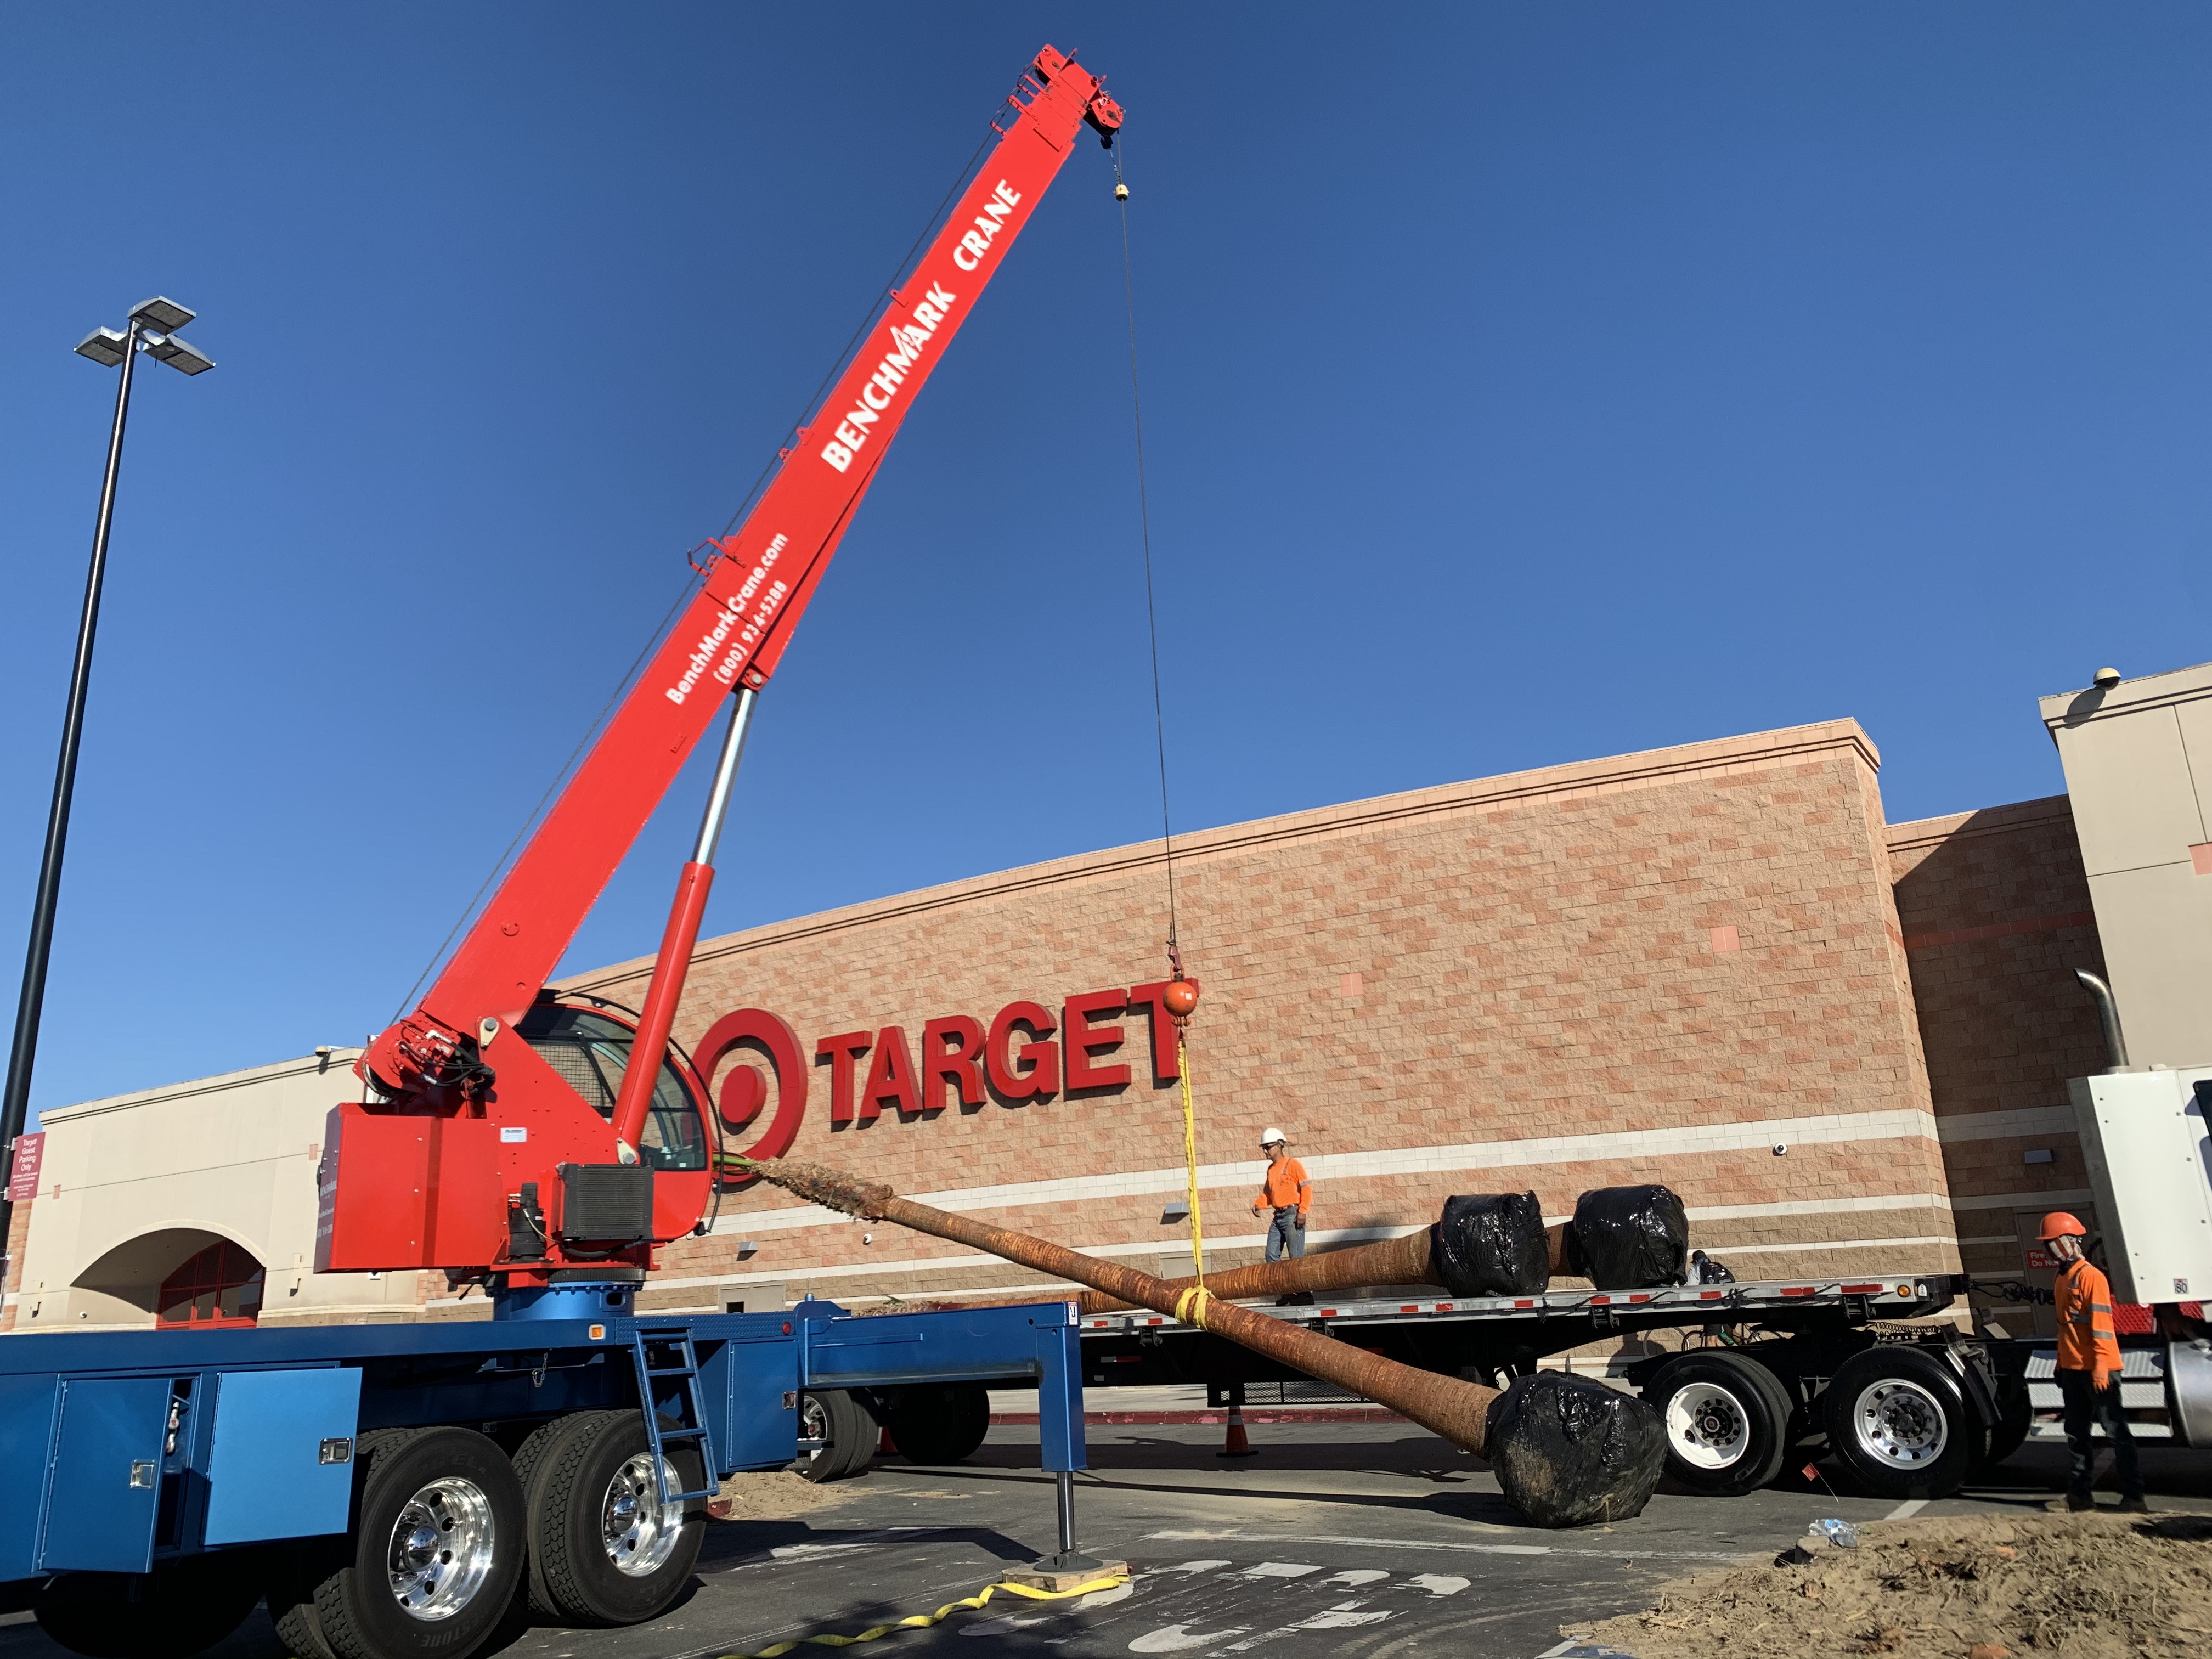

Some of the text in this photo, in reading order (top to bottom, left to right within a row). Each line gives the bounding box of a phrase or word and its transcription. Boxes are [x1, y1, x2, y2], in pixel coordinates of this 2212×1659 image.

[820, 179, 1022, 473] BENCHMARK CRANE
[665, 532, 789, 706] BenchMarkCrane.com
[713, 579, 788, 685] (800) 934-5288
[816, 977, 1199, 1121] TARGET
[21, 1163, 32, 1171] Only
[22, 1147, 36, 1155] Guest
[23, 1138, 37, 1147] Target
